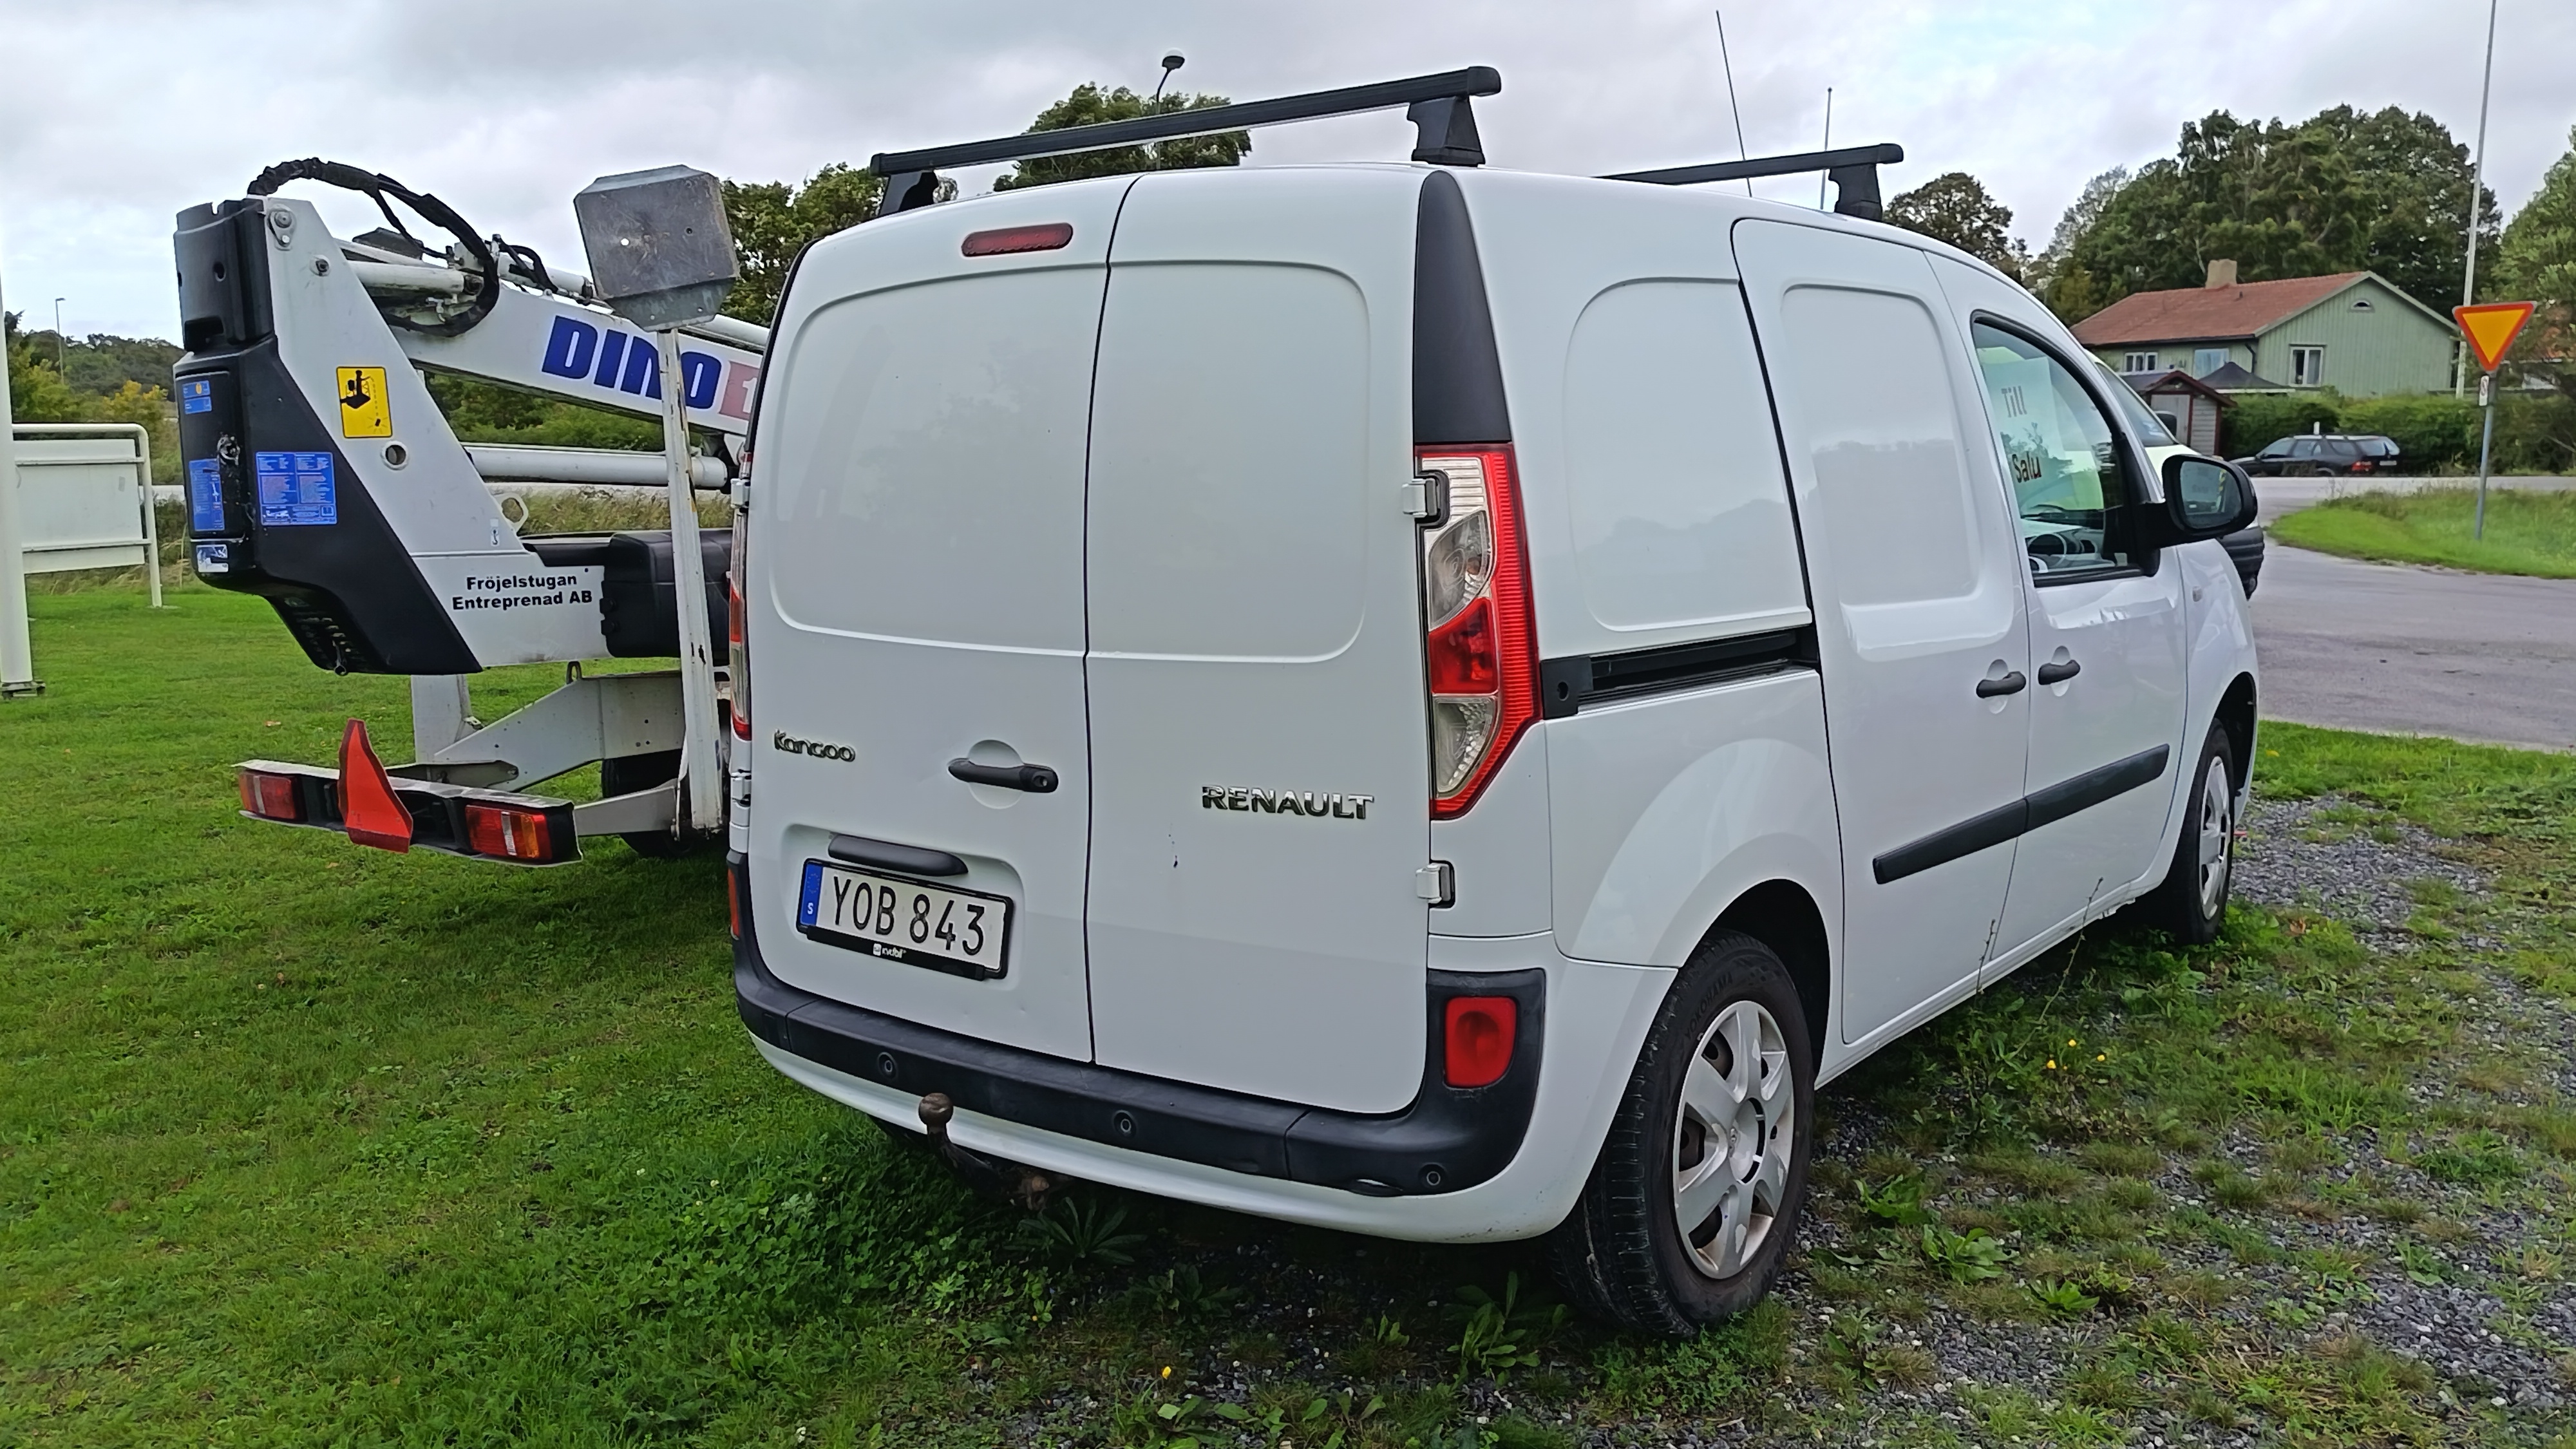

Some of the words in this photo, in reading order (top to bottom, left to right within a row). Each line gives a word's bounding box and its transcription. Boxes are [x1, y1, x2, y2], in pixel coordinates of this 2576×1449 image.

[542, 316, 721, 409] DINO
[2001, 386, 2027, 418] Till
[2012, 451, 2042, 483] Salu
[467, 575, 577, 592] Fröjelstugan
[452, 591, 563, 611] Entreprenad
[569, 591, 592, 603] AB
[1202, 785, 1374, 819] RENAULT
[806, 902, 813, 914] S
[833, 876, 896, 936] YOB
[909, 894, 985, 956] 843
[1683, 971, 1734, 1041] YOKOHAMA
